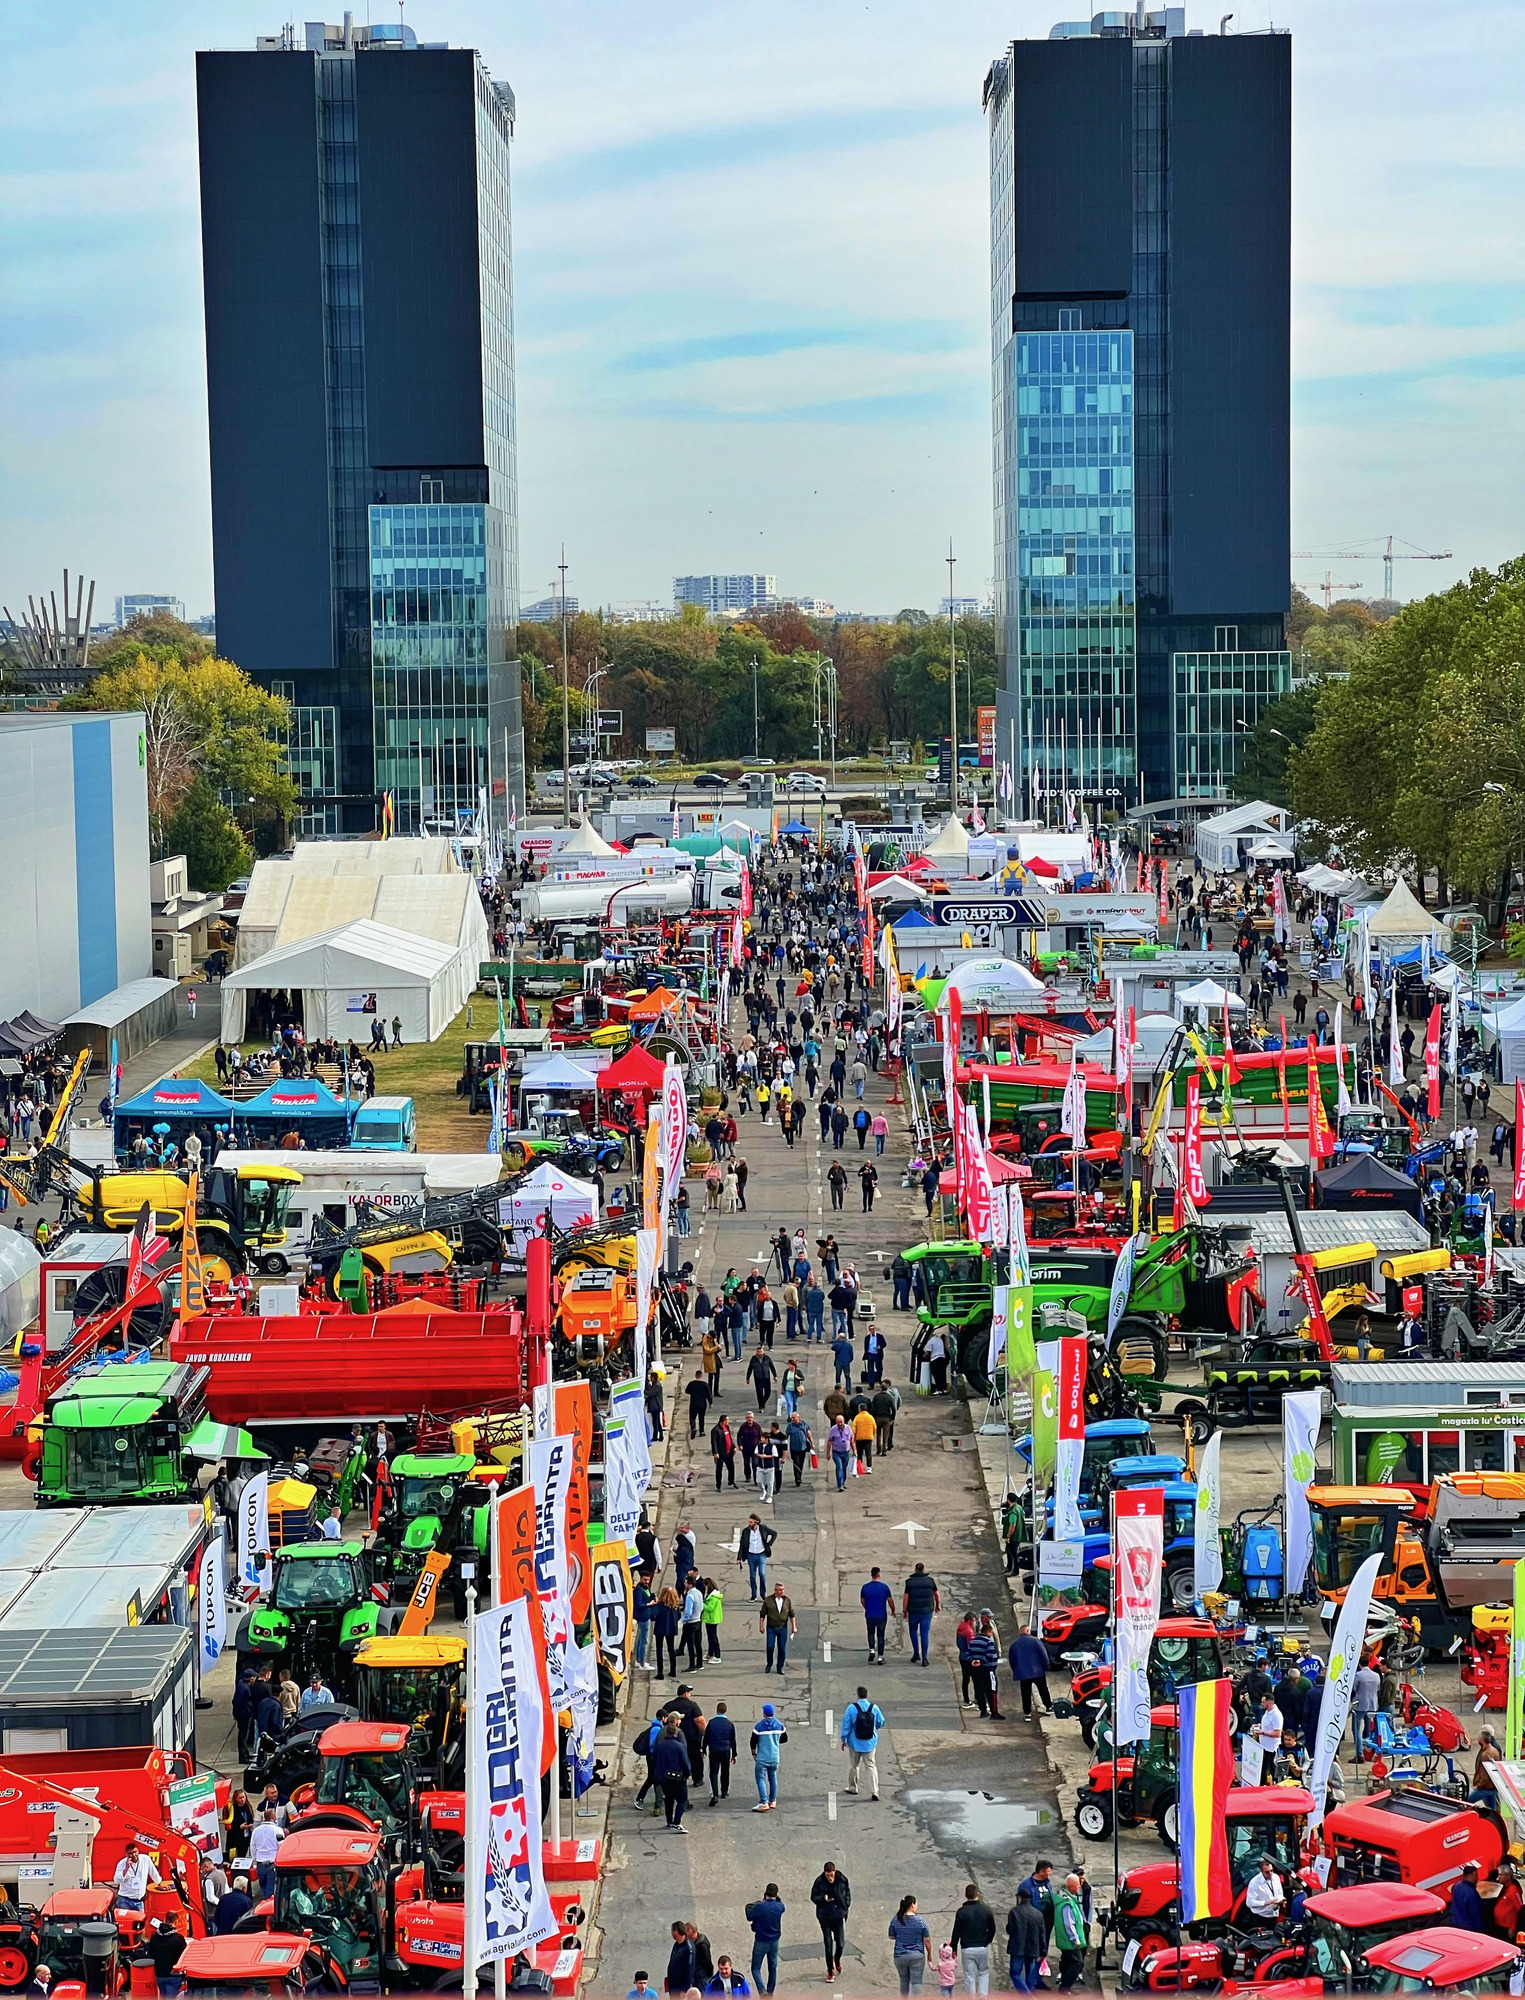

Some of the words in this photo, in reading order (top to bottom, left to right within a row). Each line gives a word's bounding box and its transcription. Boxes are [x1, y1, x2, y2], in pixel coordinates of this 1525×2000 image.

[1105, 788, 1122, 796] CO.
[948, 908, 1009, 921] DRAPER
[1187, 1086, 1206, 1198] SIPTEC
[349, 1194, 418, 1206] KALORBOX
[501, 1218, 533, 1226] TATANO
[1029, 1268, 1061, 1279] Grim
[1302, 1279, 1317, 1318] FARESIN
[185, 1354, 207, 1363] ZAVOD
[209, 1353, 252, 1362] KOBZARENKO
[610, 1510, 638, 1524] DEUT
[613, 1521, 637, 1533] FAH
[206, 1559, 215, 1631] TOPCON
[415, 1572, 436, 1608] JCB
